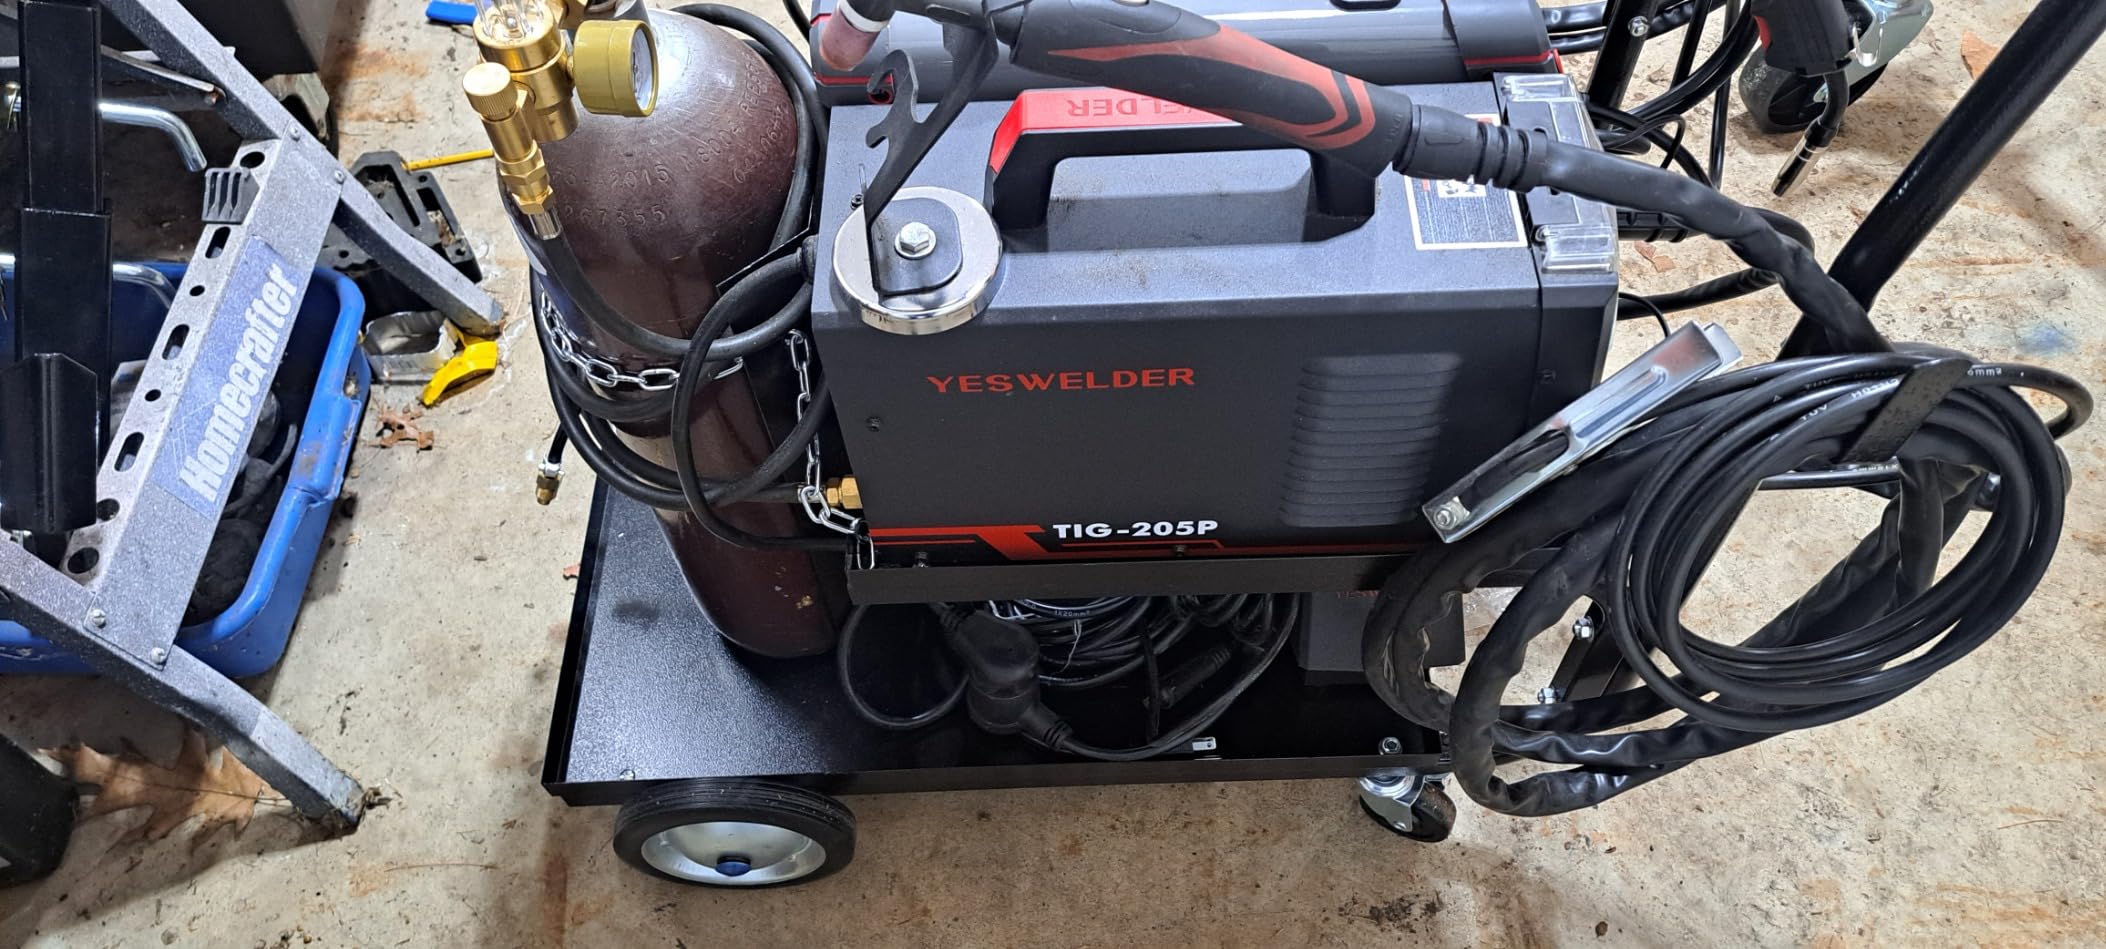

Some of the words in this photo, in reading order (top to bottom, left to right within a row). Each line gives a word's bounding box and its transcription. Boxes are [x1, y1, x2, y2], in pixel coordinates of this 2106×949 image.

[1067, 97, 1194, 116] ELDER
[180, 262, 297, 502] Homecrafter
[927, 368, 1195, 393] YESWELDER
[1053, 520, 1218, 539] TIG-205P
